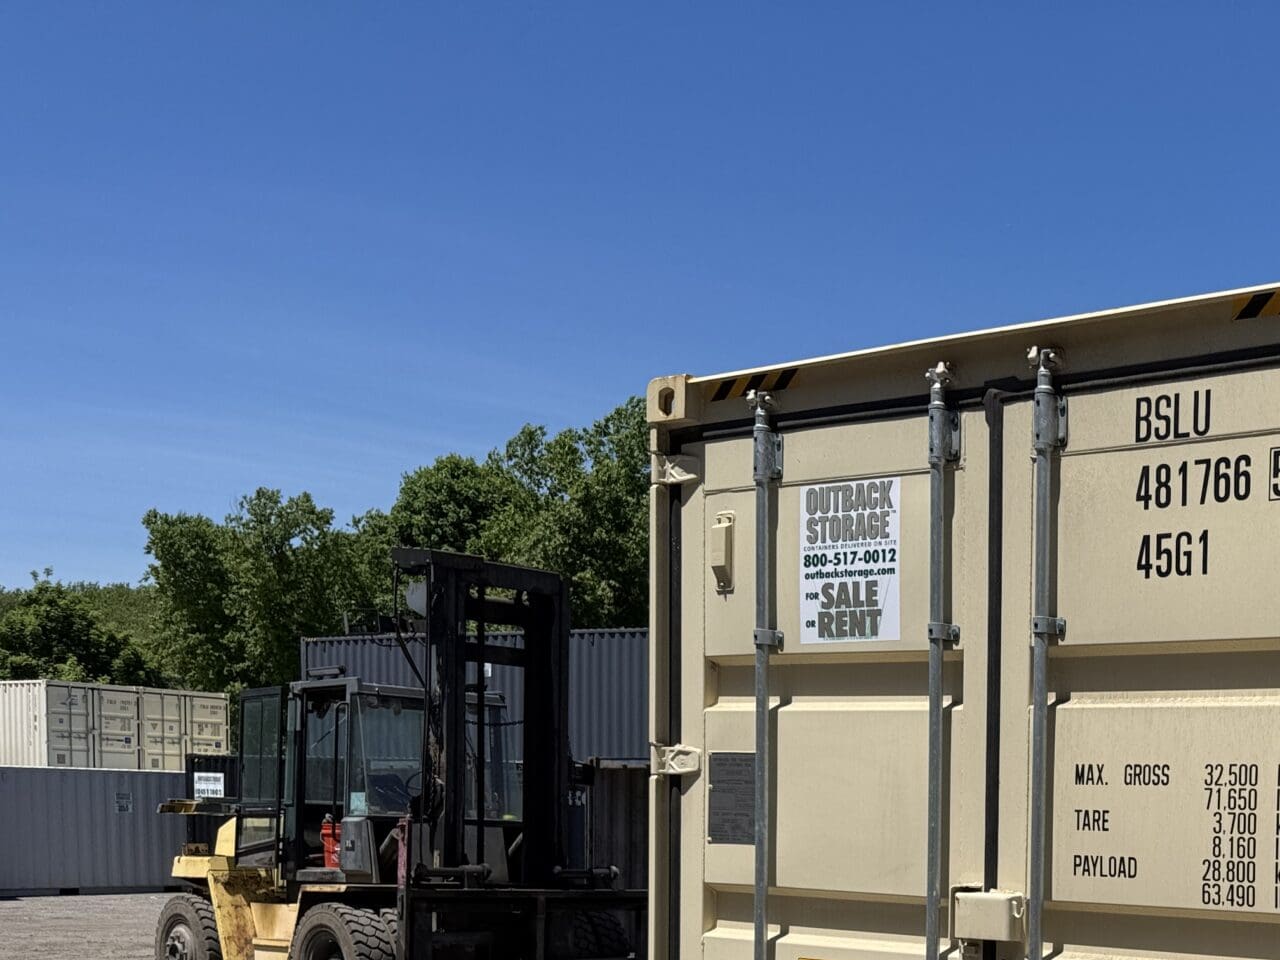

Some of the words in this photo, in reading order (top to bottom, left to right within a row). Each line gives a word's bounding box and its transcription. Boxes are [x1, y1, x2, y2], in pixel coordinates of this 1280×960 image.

[1135, 389, 1211, 443] BSLU
[1135, 454, 1251, 510] 481766
[806, 480, 893, 515] OUTBACK
[806, 511, 890, 544] STORAGE
[803, 548, 897, 568] 800-517-0012
[840, 540, 872, 550] DELIVERED
[1136, 529, 1208, 579] 45G1
[804, 567, 896, 580] outbackstorage.com
[805, 592, 819, 601] FOR
[820, 580, 879, 610] SALE
[805, 619, 816, 629] OR
[817, 609, 882, 638] RENT
[1074, 763, 1109, 786] MAX.
[1124, 763, 1171, 786] GROSS
[1074, 809, 1110, 832] TARE
[1073, 854, 1138, 879] PAYLOAD
